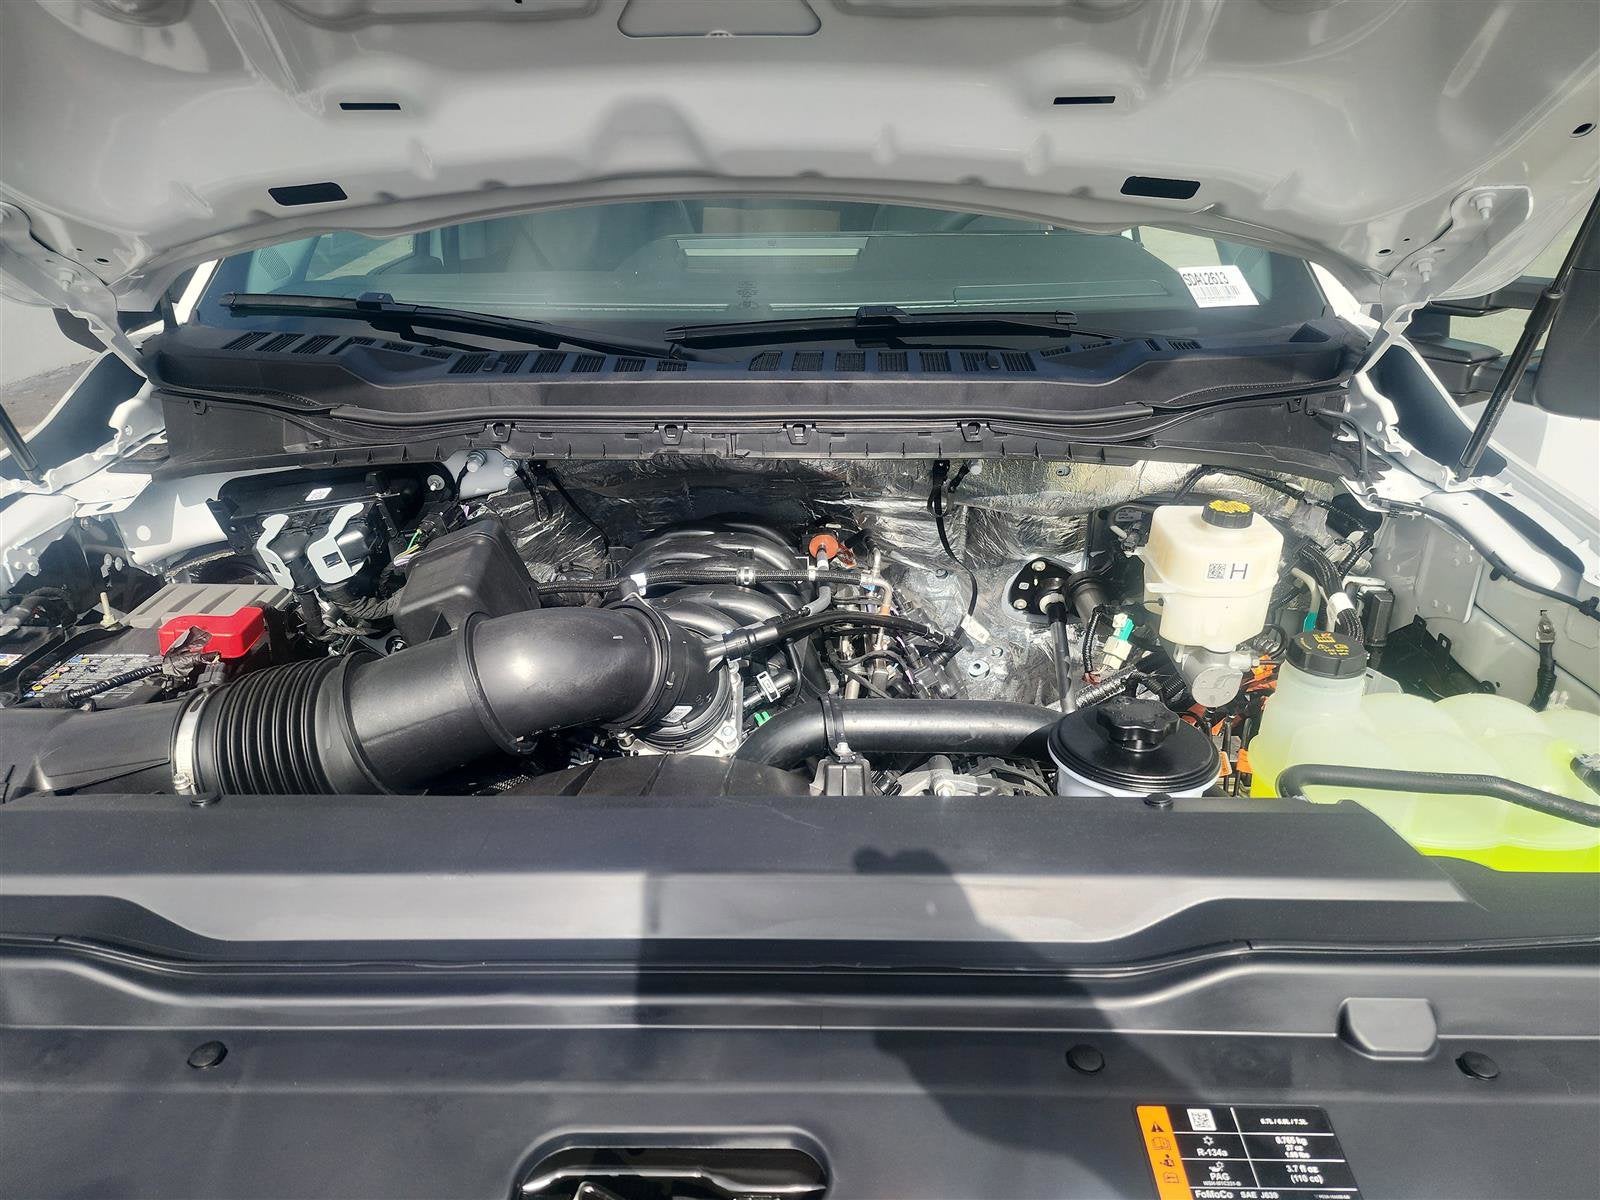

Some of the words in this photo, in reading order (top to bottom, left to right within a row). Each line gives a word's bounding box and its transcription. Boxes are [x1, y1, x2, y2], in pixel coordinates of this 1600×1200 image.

[1229, 563, 1249, 580] H
[1197, 1148, 1229, 1157] R-134a
[1286, 1165, 1298, 1173] 3.7
[1209, 1173, 1230, 1181] PAG
[1194, 1190, 1234, 1199] FoMoCo
[1240, 1191, 1258, 1199] SAE
